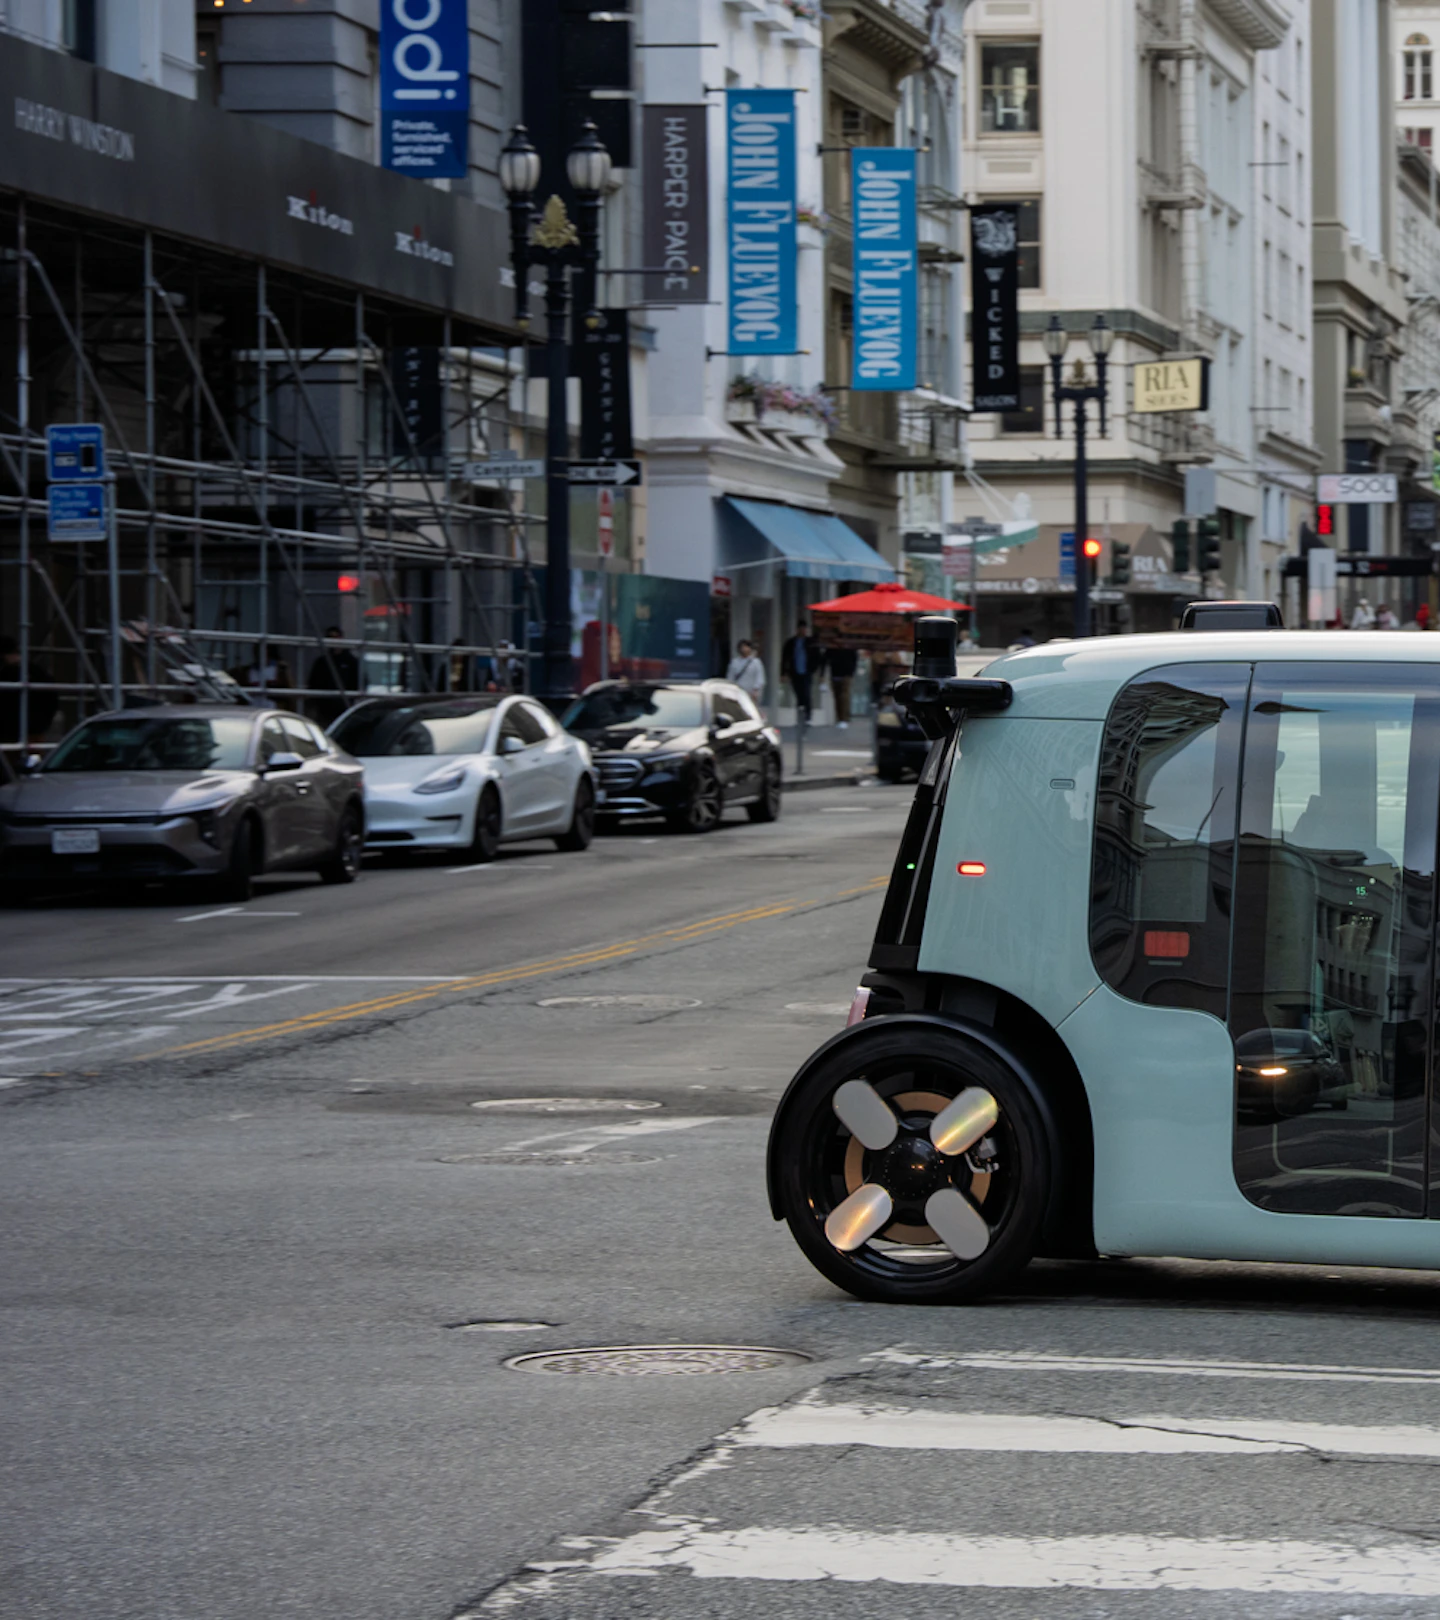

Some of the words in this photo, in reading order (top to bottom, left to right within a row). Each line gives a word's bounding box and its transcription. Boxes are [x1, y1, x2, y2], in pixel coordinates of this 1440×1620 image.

[15, 97, 65, 141] HARRY
[68, 114, 134, 161] WINSTON
[663, 117, 688, 208] HARPER
[731, 102, 792, 189] JOHN
[287, 190, 354, 235] Kiton
[857, 161, 912, 239] JOHN
[395, 225, 454, 267] Kiton
[664, 221, 689, 290] PAIGE
[731, 200, 793, 342] FLUEVOG
[858, 250, 913, 378] FLUEVOG
[984, 267, 1004, 379] WICKED
[1144, 365, 1189, 392] RIA
[473, 465, 535, 477] Campton
